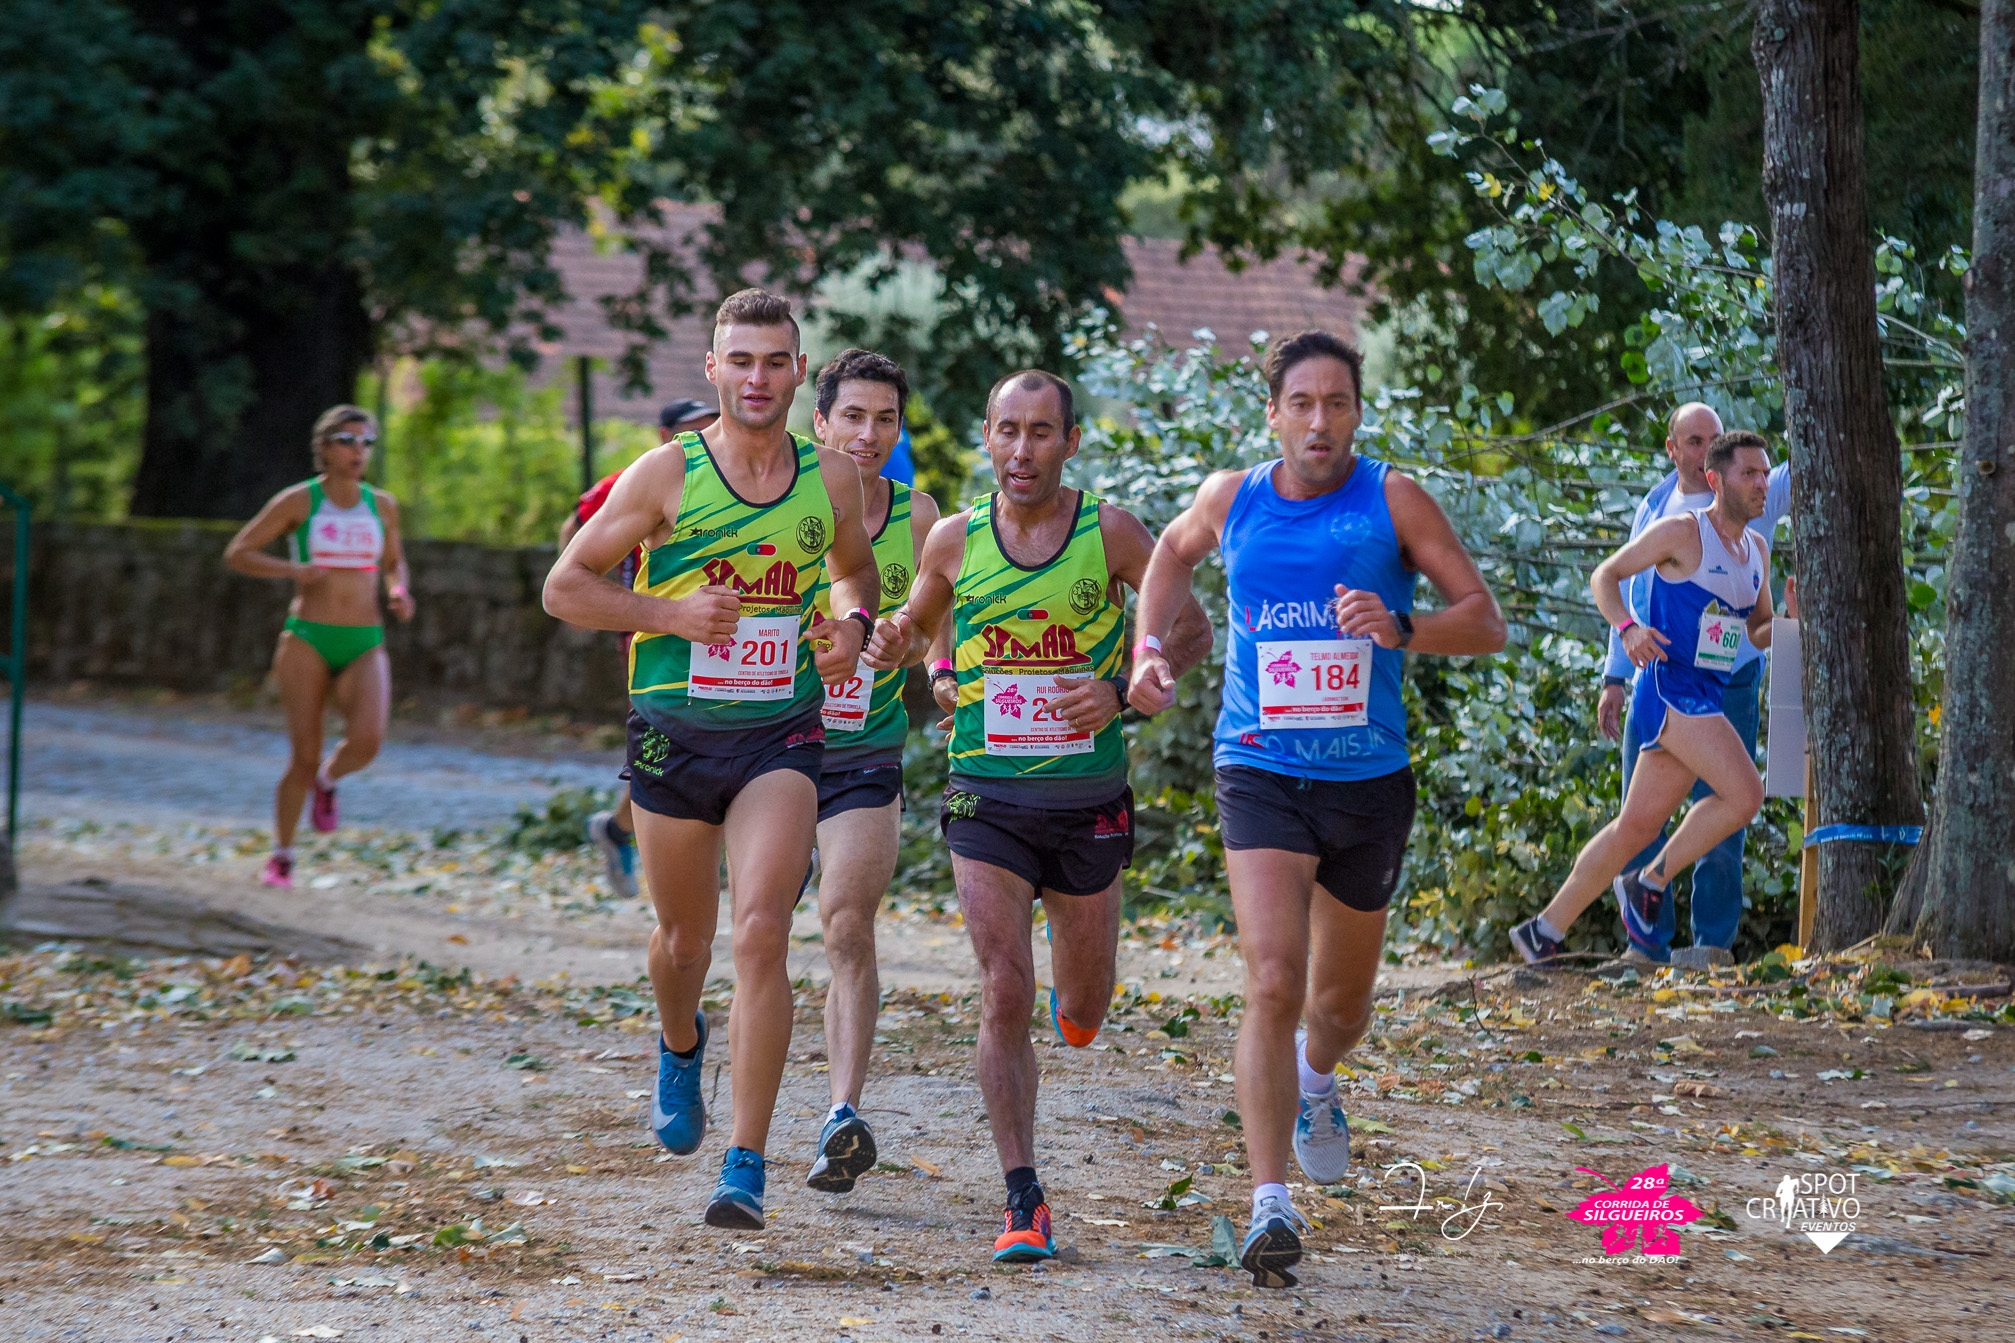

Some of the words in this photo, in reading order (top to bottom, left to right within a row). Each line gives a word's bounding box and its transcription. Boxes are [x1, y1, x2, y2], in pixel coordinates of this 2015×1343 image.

[758, 628, 780, 637] MARITO
[740, 640, 789, 666] 201
[733, 677, 751, 686] berço
[751, 678, 760, 686] do
[1310, 663, 1361, 691] 184
[823, 676, 863, 699] 02
[1036, 686, 1047, 694] RUI
[1027, 734, 1044, 743] berço
